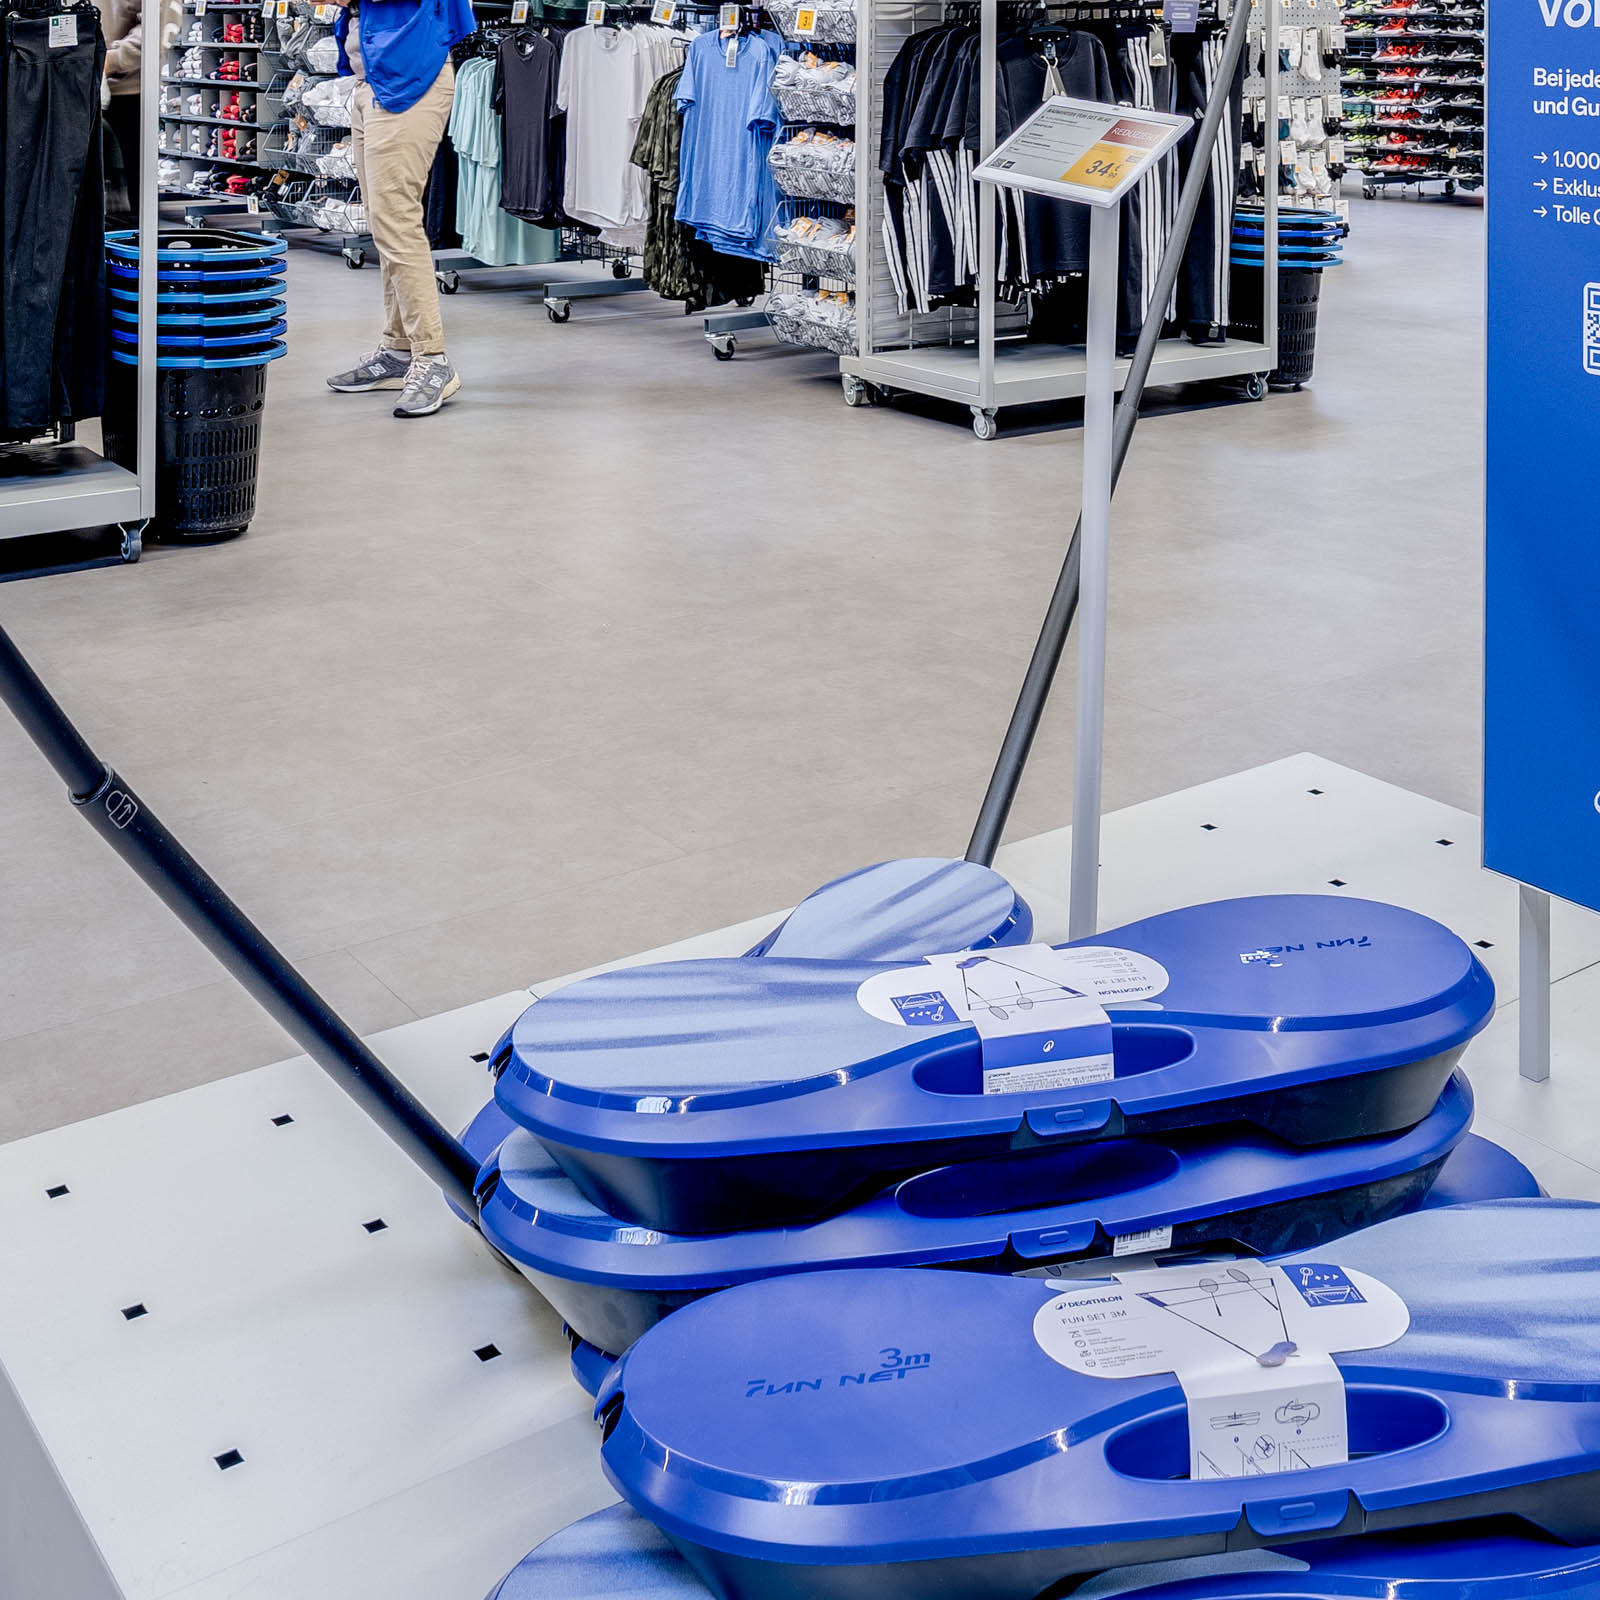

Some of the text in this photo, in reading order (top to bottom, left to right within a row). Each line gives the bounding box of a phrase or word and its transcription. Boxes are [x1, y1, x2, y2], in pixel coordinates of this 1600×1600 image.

[1533, 68, 1562, 87] Bei
[1533, 97, 1569, 115] und
[1085, 160, 1114, 176] 34
[1553, 150, 1600, 170] 1.000
[1553, 205, 1591, 225] Tolle
[1067, 1294, 1124, 1309] DECATHLON
[1061, 1309, 1128, 1326] FUN SET 3M
[879, 1347, 931, 1369] 3m
[839, 1365, 931, 1388] NET
